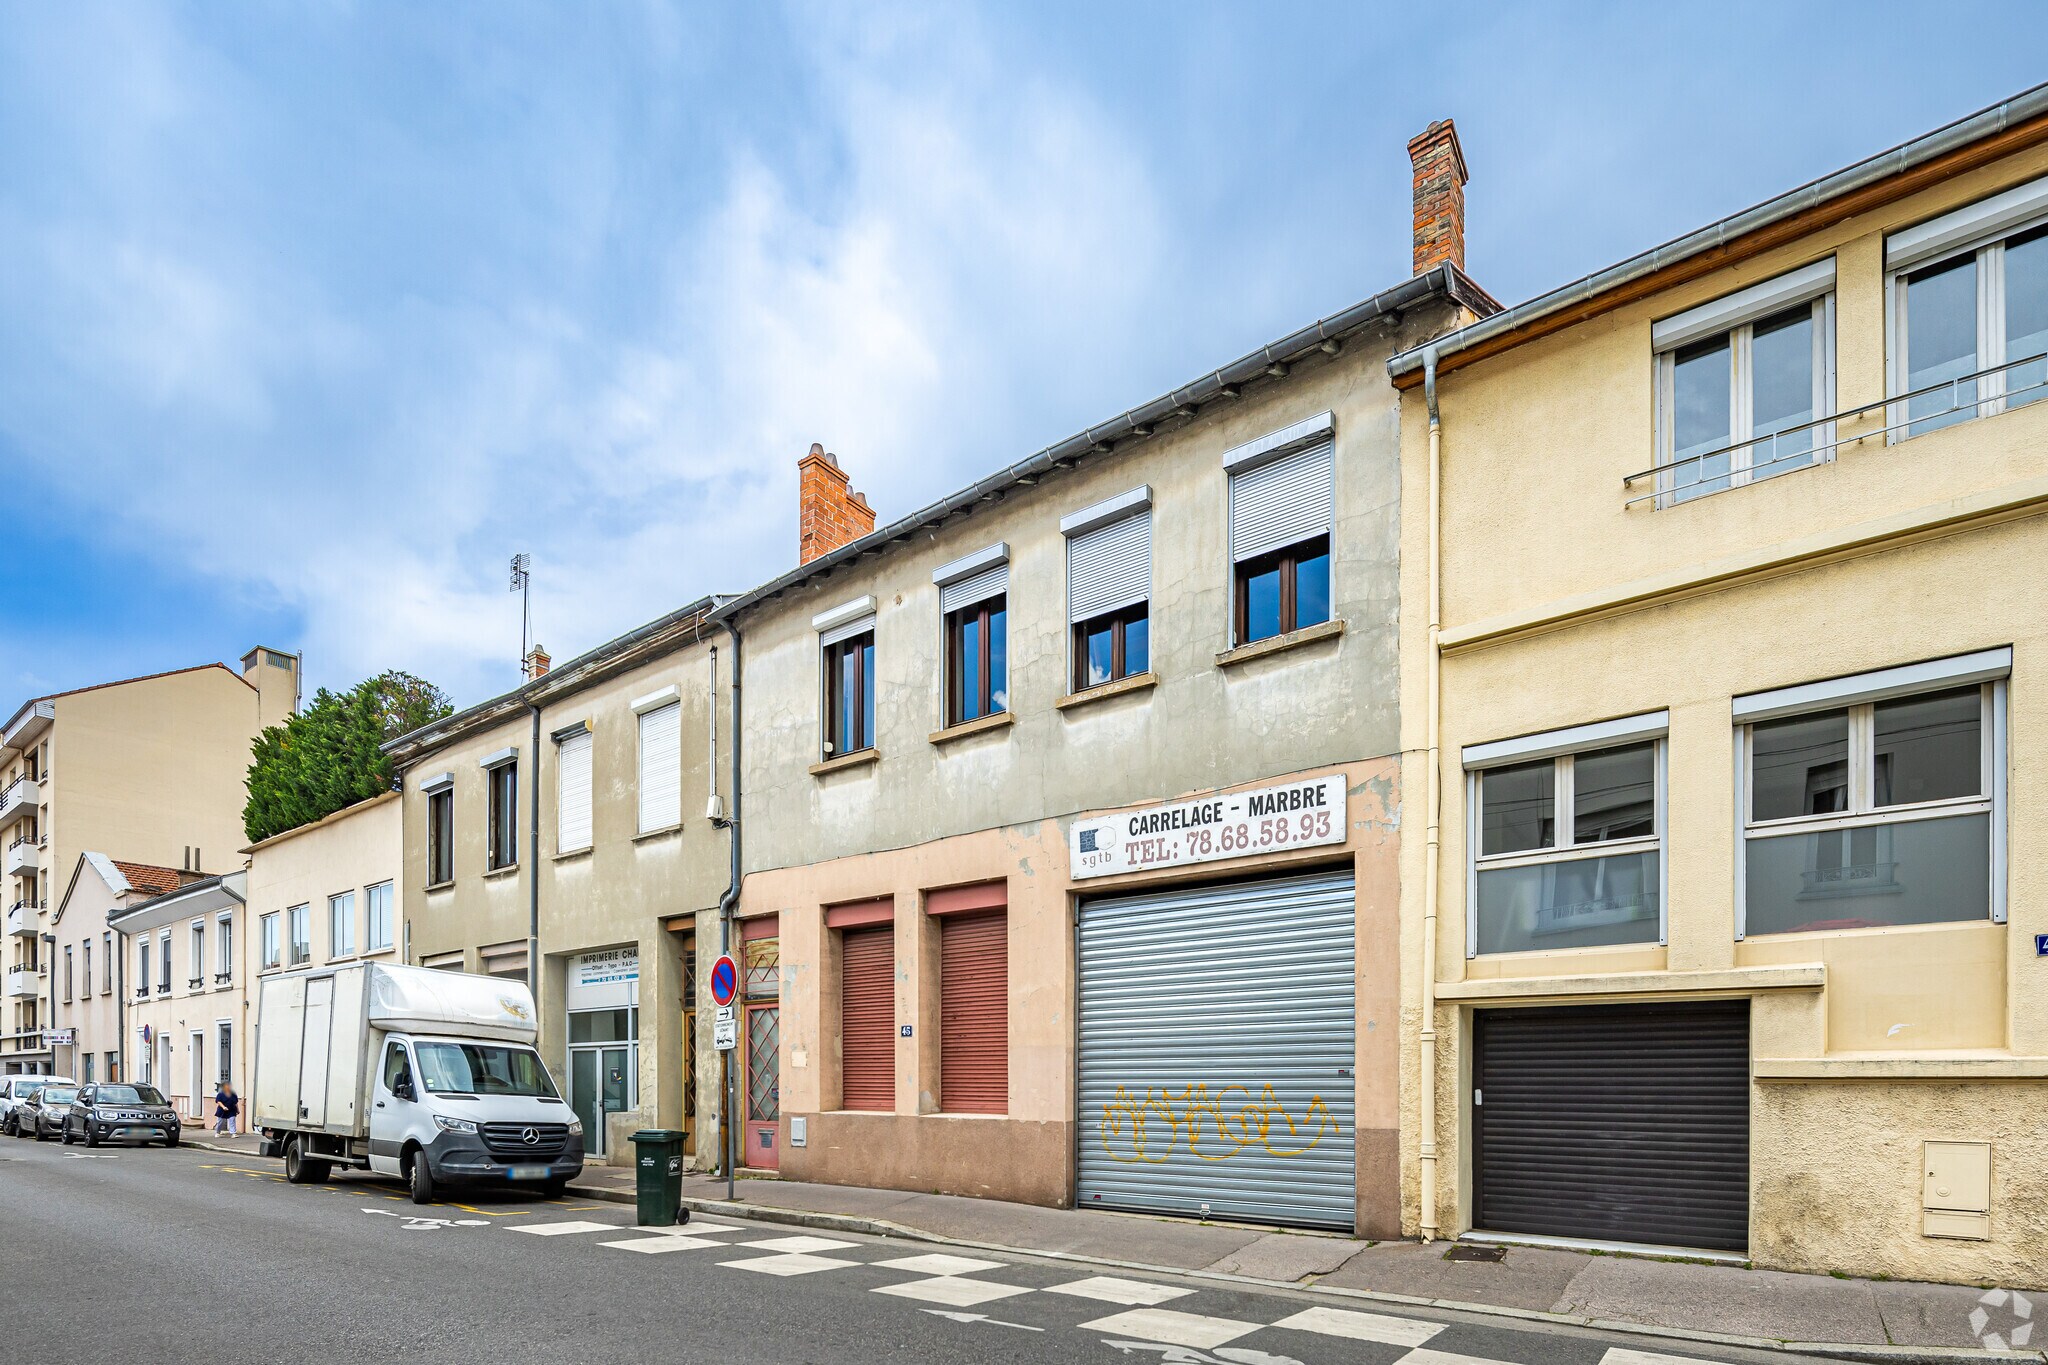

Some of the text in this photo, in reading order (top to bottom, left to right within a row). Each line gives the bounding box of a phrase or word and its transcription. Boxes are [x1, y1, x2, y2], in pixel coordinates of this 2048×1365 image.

[1128, 802, 1223, 837] CARRELAGE
[1248, 784, 1327, 818] MARBRE
[1125, 810, 1331, 866] TEL: 78.68.58.93
[1082, 851, 1112, 868] sgtb
[581, 951, 618, 964] IMPRIMERIE
[902, 1026, 911, 1035] 45
